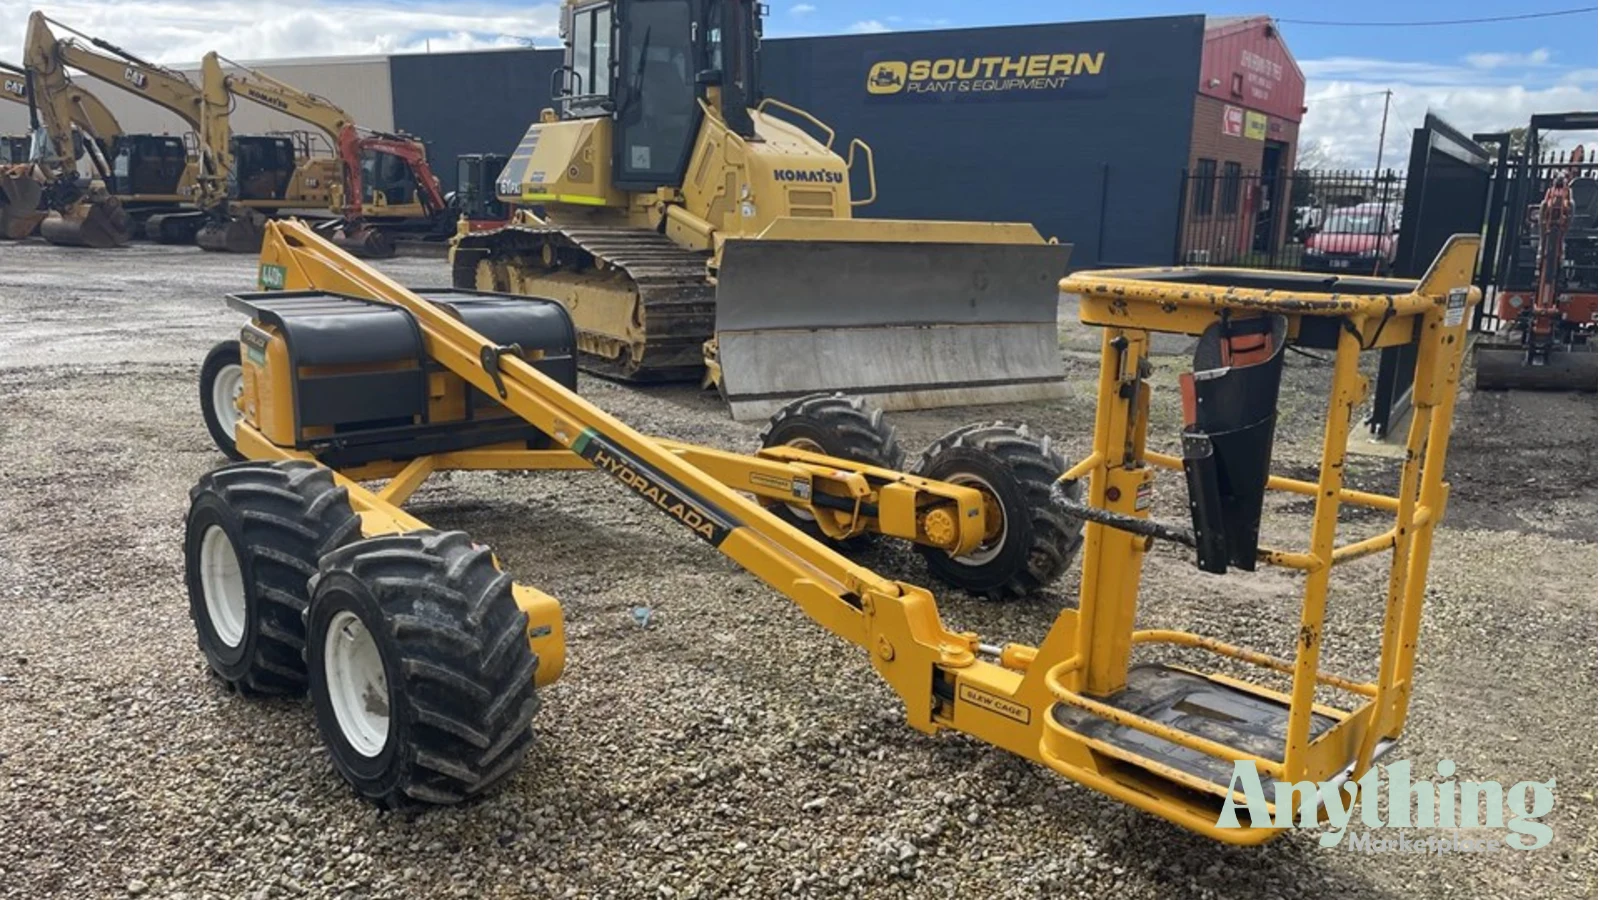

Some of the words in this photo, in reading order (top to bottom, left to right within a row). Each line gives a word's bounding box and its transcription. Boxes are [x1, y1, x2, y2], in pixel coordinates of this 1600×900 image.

[908, 52, 1105, 81] SOUTHERN
[125, 67, 147, 87] CAT
[907, 80, 957, 93] PLANT
[958, 79, 970, 91] &
[972, 76, 1070, 91] EQUIPMENT
[4, 79, 24, 96] CAT
[773, 168, 843, 183] KOMATSU
[594, 450, 715, 540] HYDRALADA
[967, 690, 993, 705] SLEW
[994, 701, 1023, 716] CAGE
